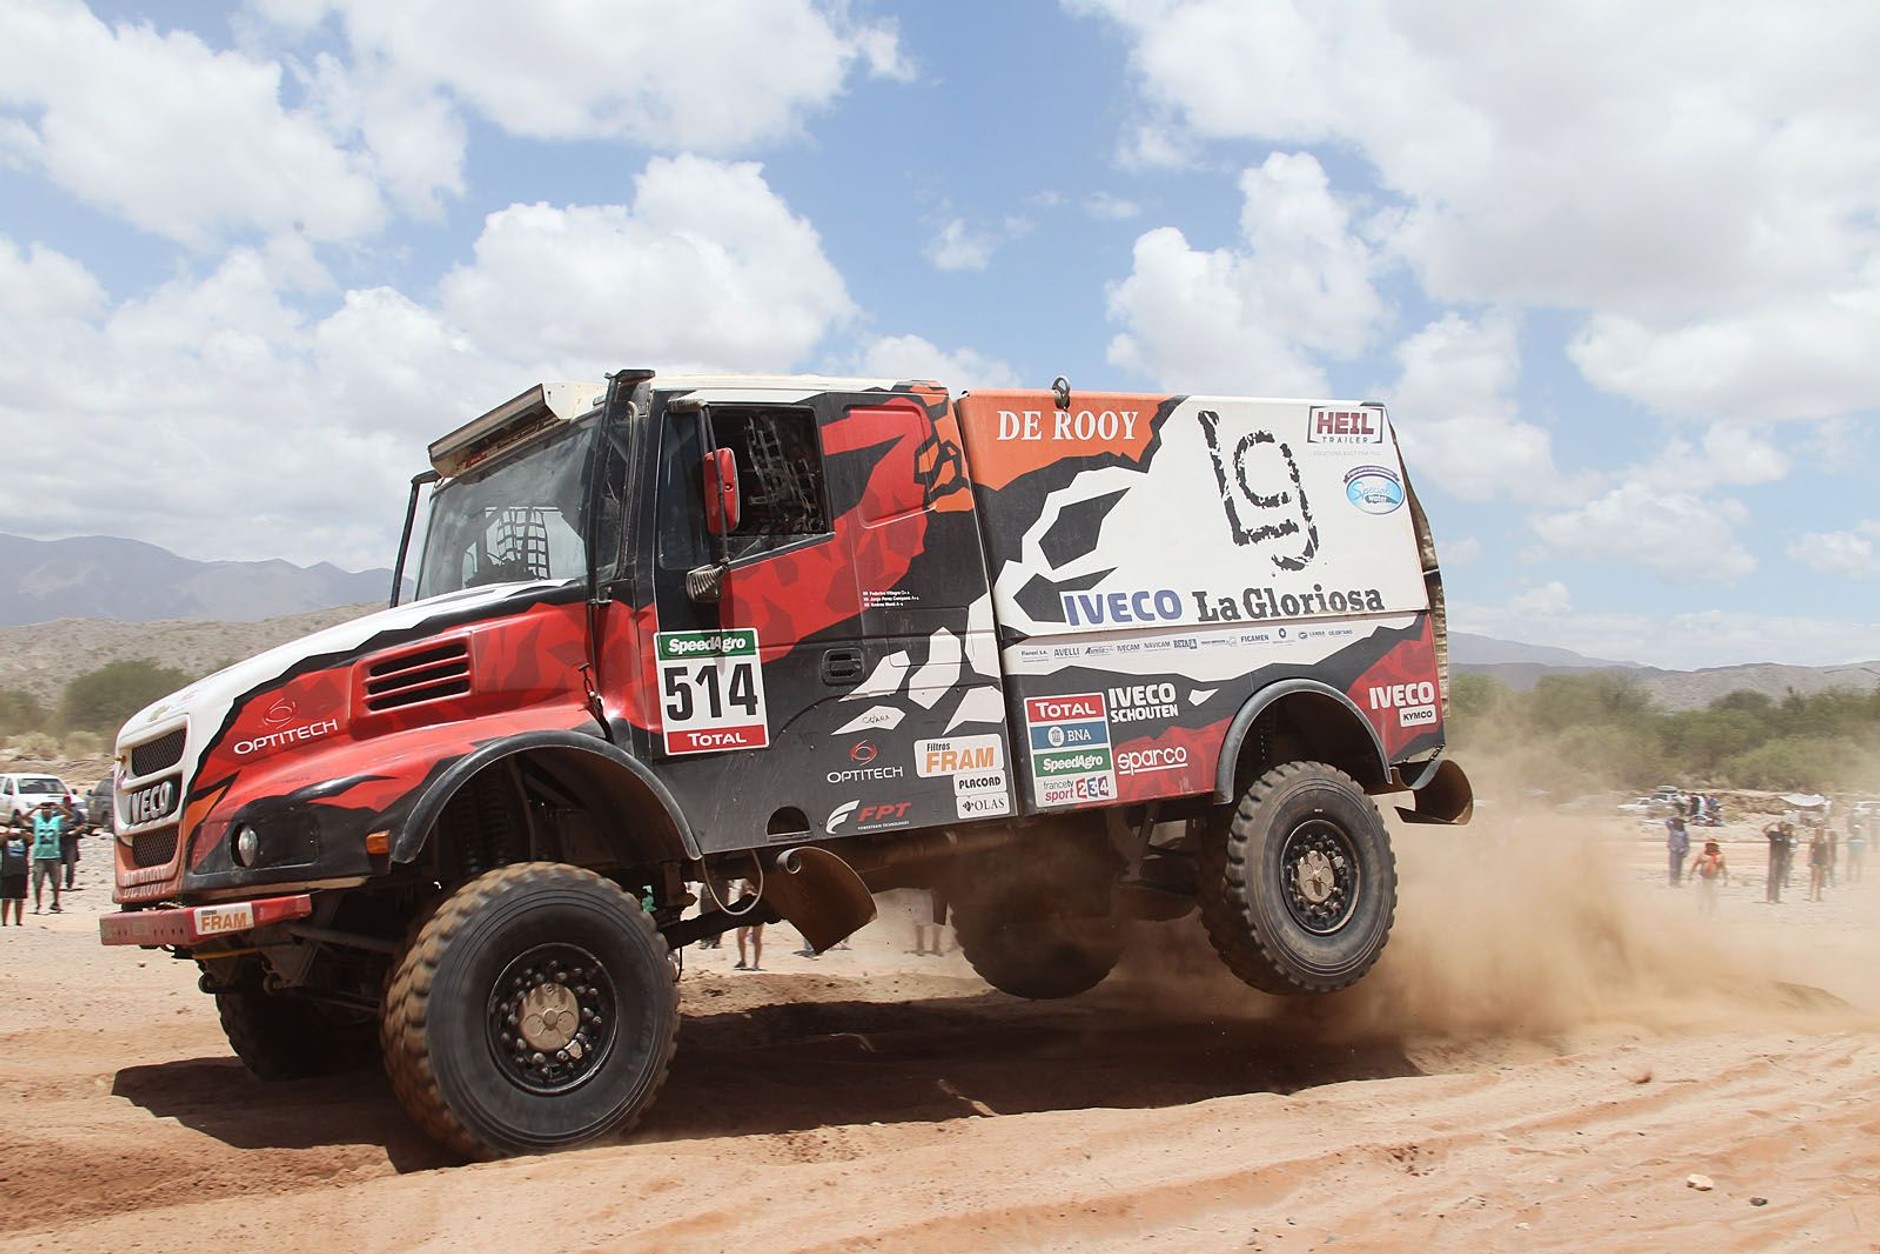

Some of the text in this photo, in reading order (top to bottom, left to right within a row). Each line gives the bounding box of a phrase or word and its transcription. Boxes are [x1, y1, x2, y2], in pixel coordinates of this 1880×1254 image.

[997, 410, 1139, 441] DE ROOY
[1316, 412, 1375, 435] HEIL
[1064, 590, 1182, 626] IVECO
[668, 636, 747, 655] SpeedAgro
[1241, 634, 1270, 643] FICAMEN
[1054, 647, 1080, 657] AVELLI
[664, 663, 758, 721] 514
[1108, 683, 1176, 709] IVECO
[1369, 681, 1435, 709] IVECO
[1035, 702, 1096, 718] TOTAL
[1111, 704, 1179, 723] SCHOUTEN
[1403, 710, 1433, 721] KYMCO
[234, 718, 338, 755] OPTITECH
[687, 733, 747, 747] TOTAL
[1067, 728, 1092, 742] BNA
[927, 743, 951, 752] Filtros
[926, 747, 994, 773] FRAM
[1043, 755, 1104, 773] SpeedAgro
[1117, 746, 1187, 775] sparco
[827, 766, 904, 783] OPTITECH
[959, 777, 1001, 789] PLACORD
[128, 780, 174, 825] IVECO
[1045, 787, 1074, 802] sport
[858, 802, 912, 822] FPT
[974, 798, 1005, 811] OLAS
[201, 911, 247, 931] FRAM
